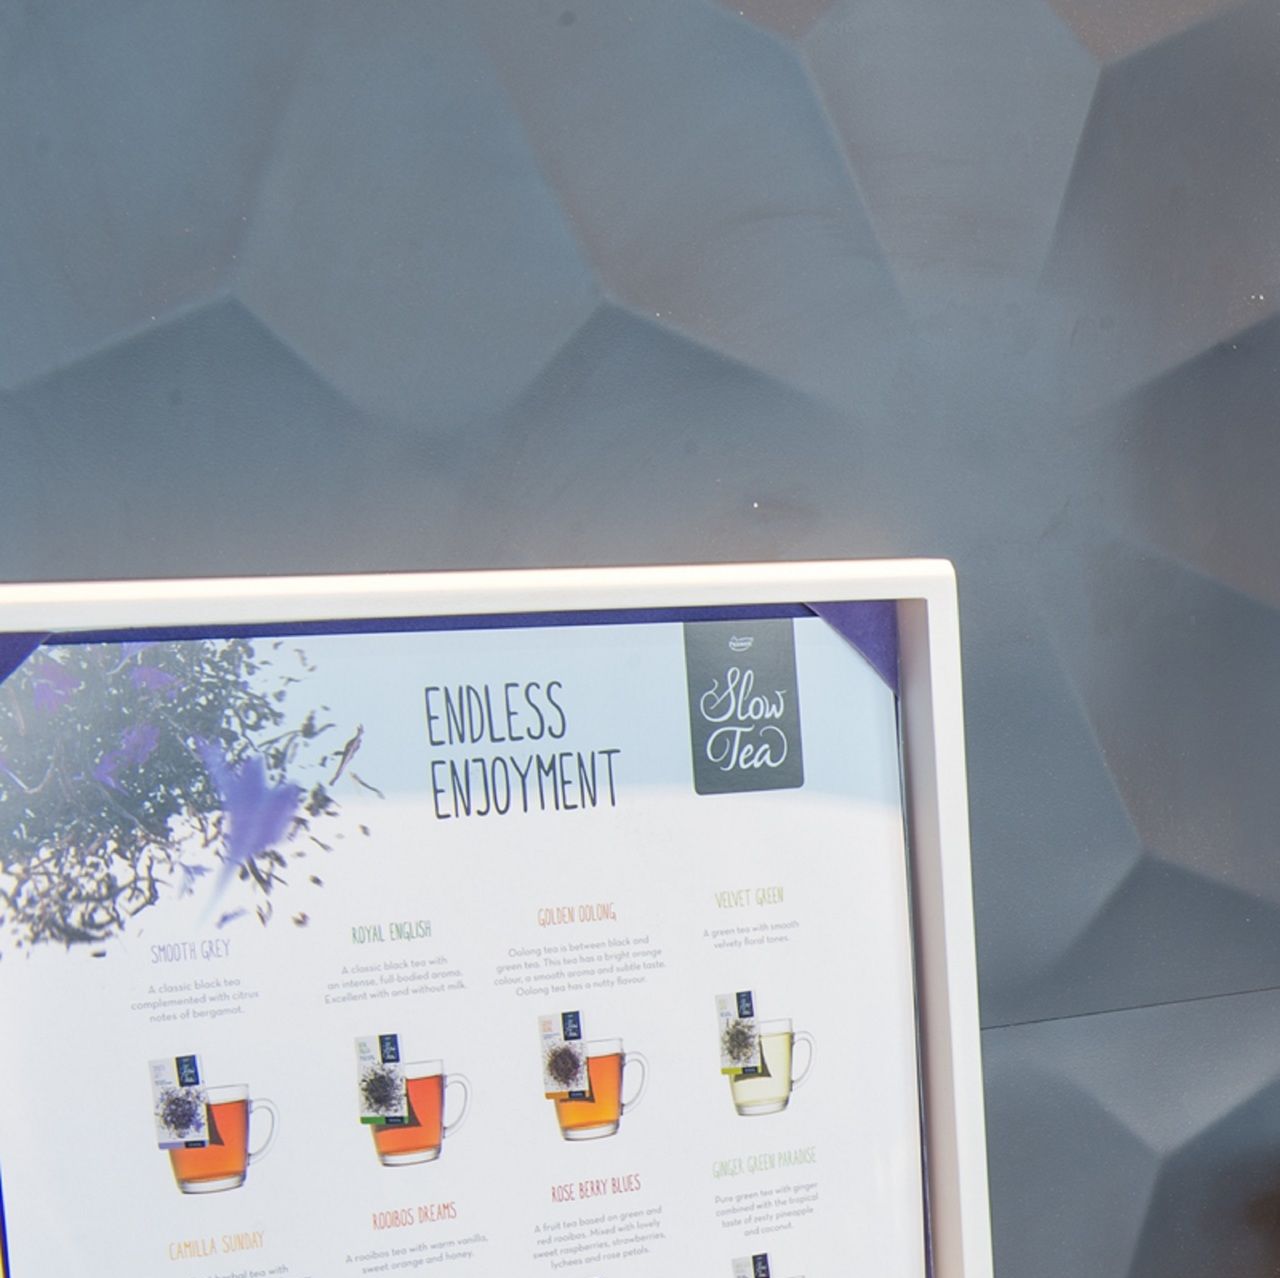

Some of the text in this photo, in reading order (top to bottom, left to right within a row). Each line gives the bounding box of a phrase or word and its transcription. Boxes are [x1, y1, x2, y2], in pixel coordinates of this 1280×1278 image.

[700, 667, 787, 722] Slow
[424, 680, 567, 746] ENDLESS
[707, 724, 788, 771] Tea
[430, 748, 621, 819] ENJOYMENT
[715, 886, 784, 909] VELVET GREEN
[538, 902, 617, 928] GOLDEN OOLONG
[352, 920, 432, 944] ROYAL ENGLISH
[151, 938, 231, 964] SMOOTH GREY
[712, 1145, 817, 1179] GINGER GREEN PARADISE
[552, 1173, 641, 1203] ROSE BERRY BLUES
[372, 1201, 457, 1230] ROOIBOS DREAMS
[169, 1231, 264, 1261] CAMILLA SUNDAY
[250, 1269, 266, 1278] tea
[268, 1264, 289, 1274] with
